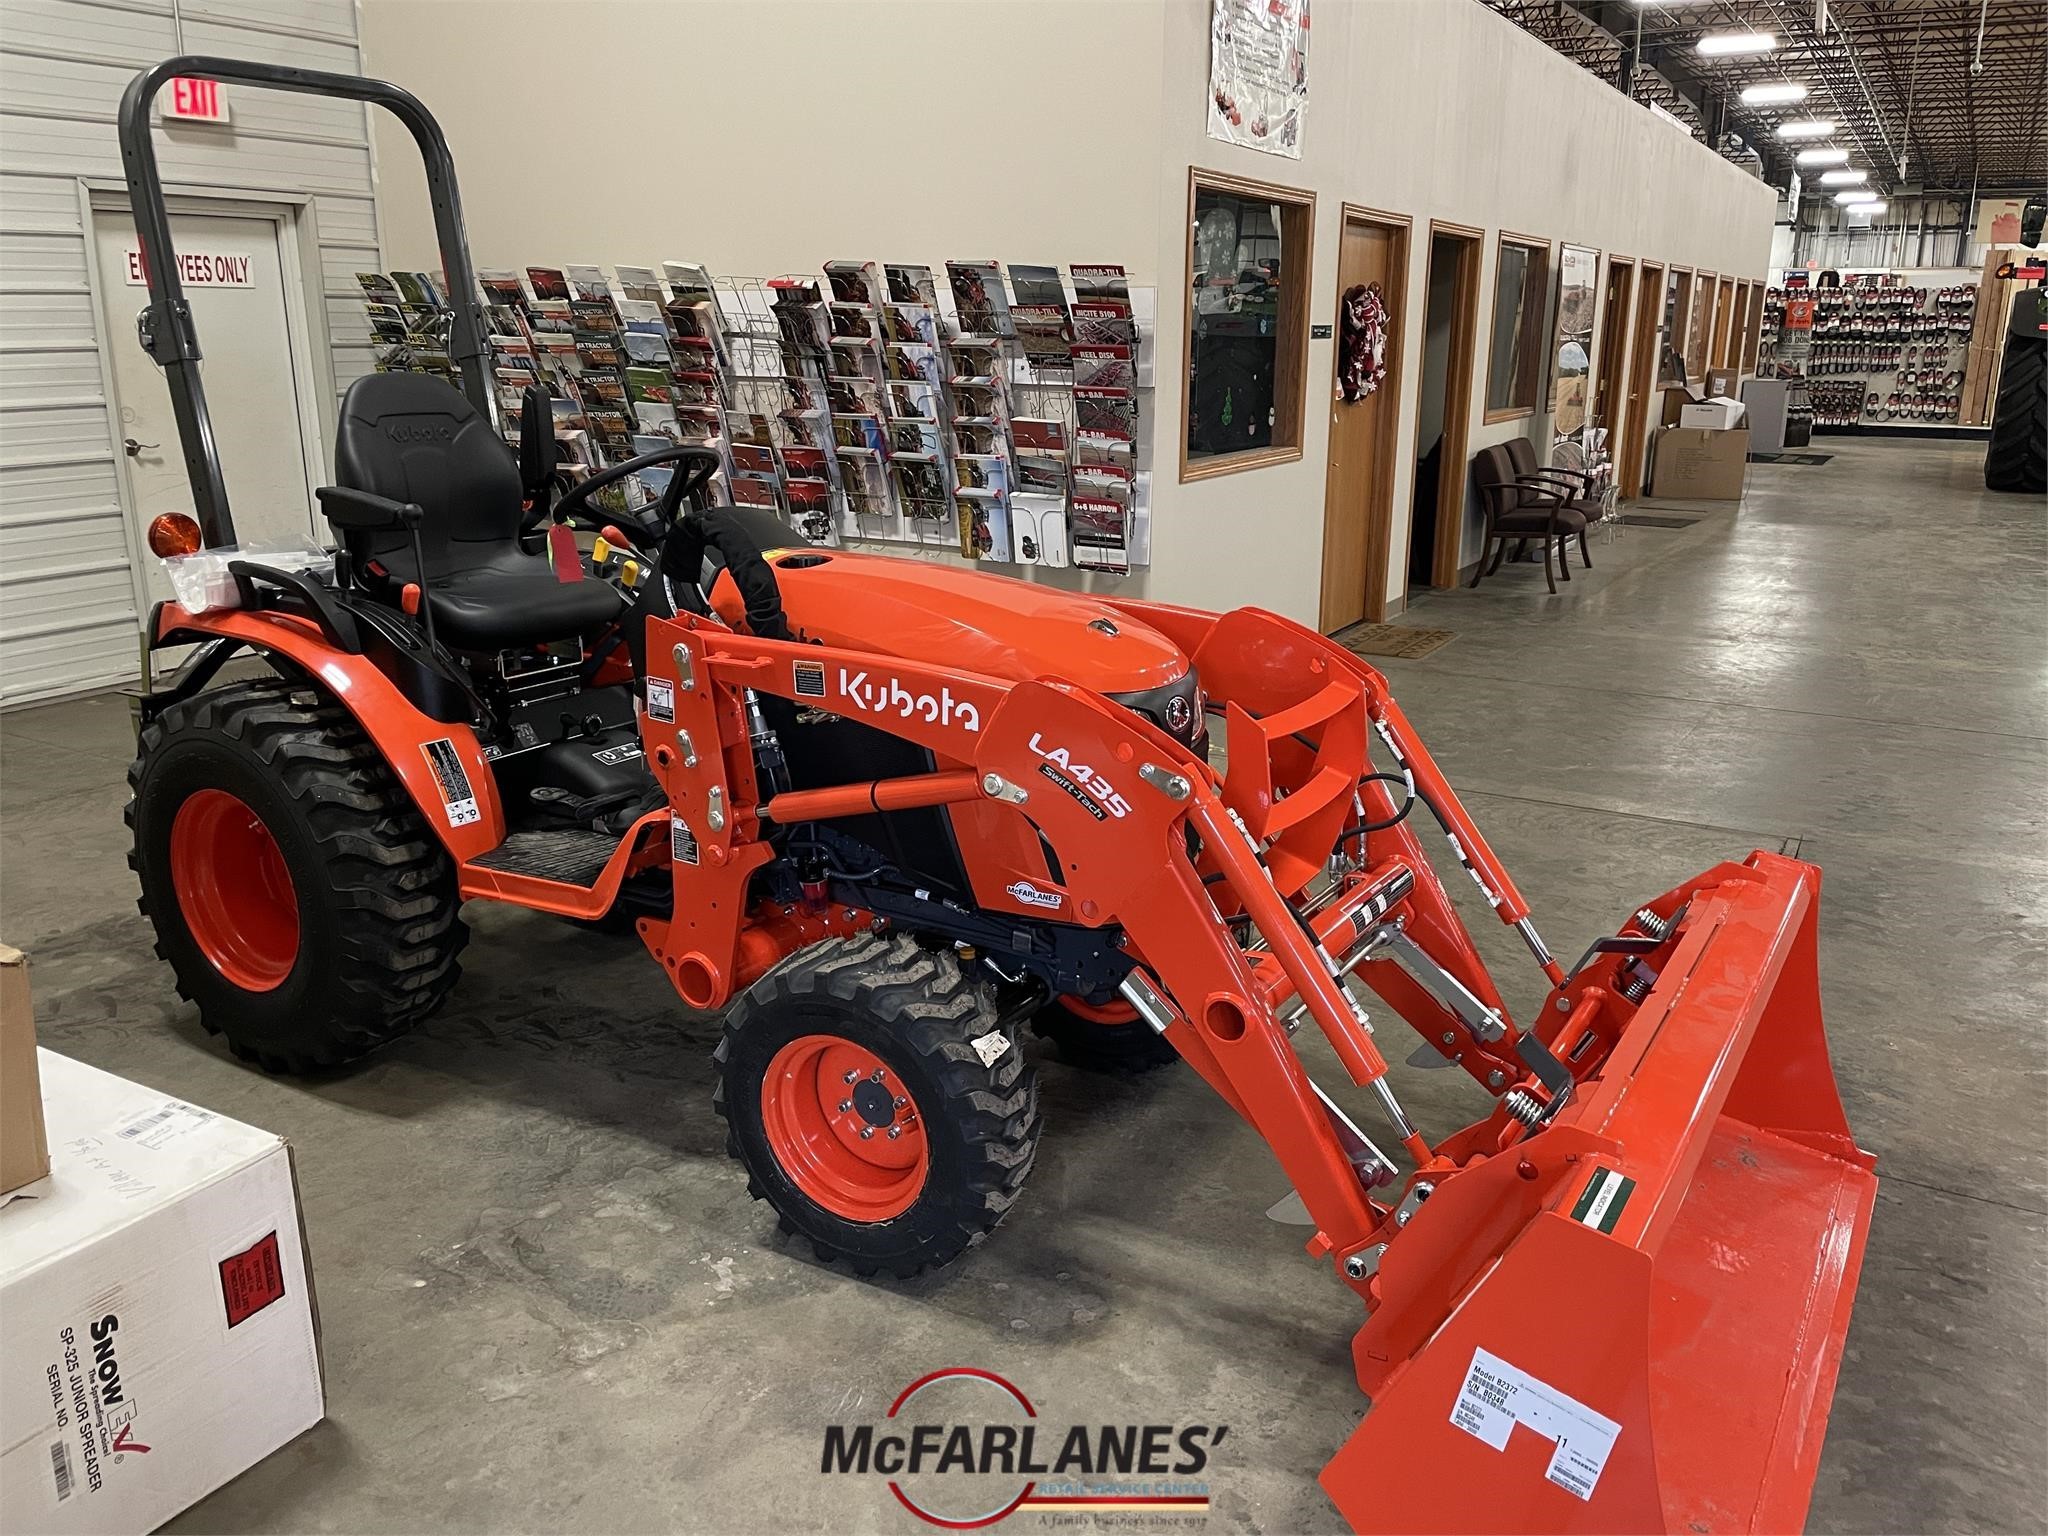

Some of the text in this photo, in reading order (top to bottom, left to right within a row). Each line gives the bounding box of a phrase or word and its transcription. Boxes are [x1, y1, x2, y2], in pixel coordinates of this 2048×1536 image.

[174, 78, 218, 118] EXIT
[215, 255, 248, 284] ONLY
[1072, 268, 1121, 277] QUADRA-TILL
[1011, 307, 1058, 316] QUADRA-TILL
[1075, 309, 1117, 318] INCITE 5100
[1080, 351, 1116, 359] REEL DISK
[1088, 503, 1118, 514] HARROW
[839, 668, 980, 732] Kubota
[1028, 732, 1133, 818] LA435
[1042, 765, 1104, 819] Swift-Tach
[60, 1326, 79, 1373] SP-325
[1467, 1380, 1480, 1392] S/N
[1473, 1365, 1495, 1382] Model
[46, 1363, 69, 1432] SERIAL NO.
[69, 1374, 89, 1423] JUNIOR
[89, 1384, 104, 1429] Spreading
[80, 1422, 102, 1493] SPREADER
